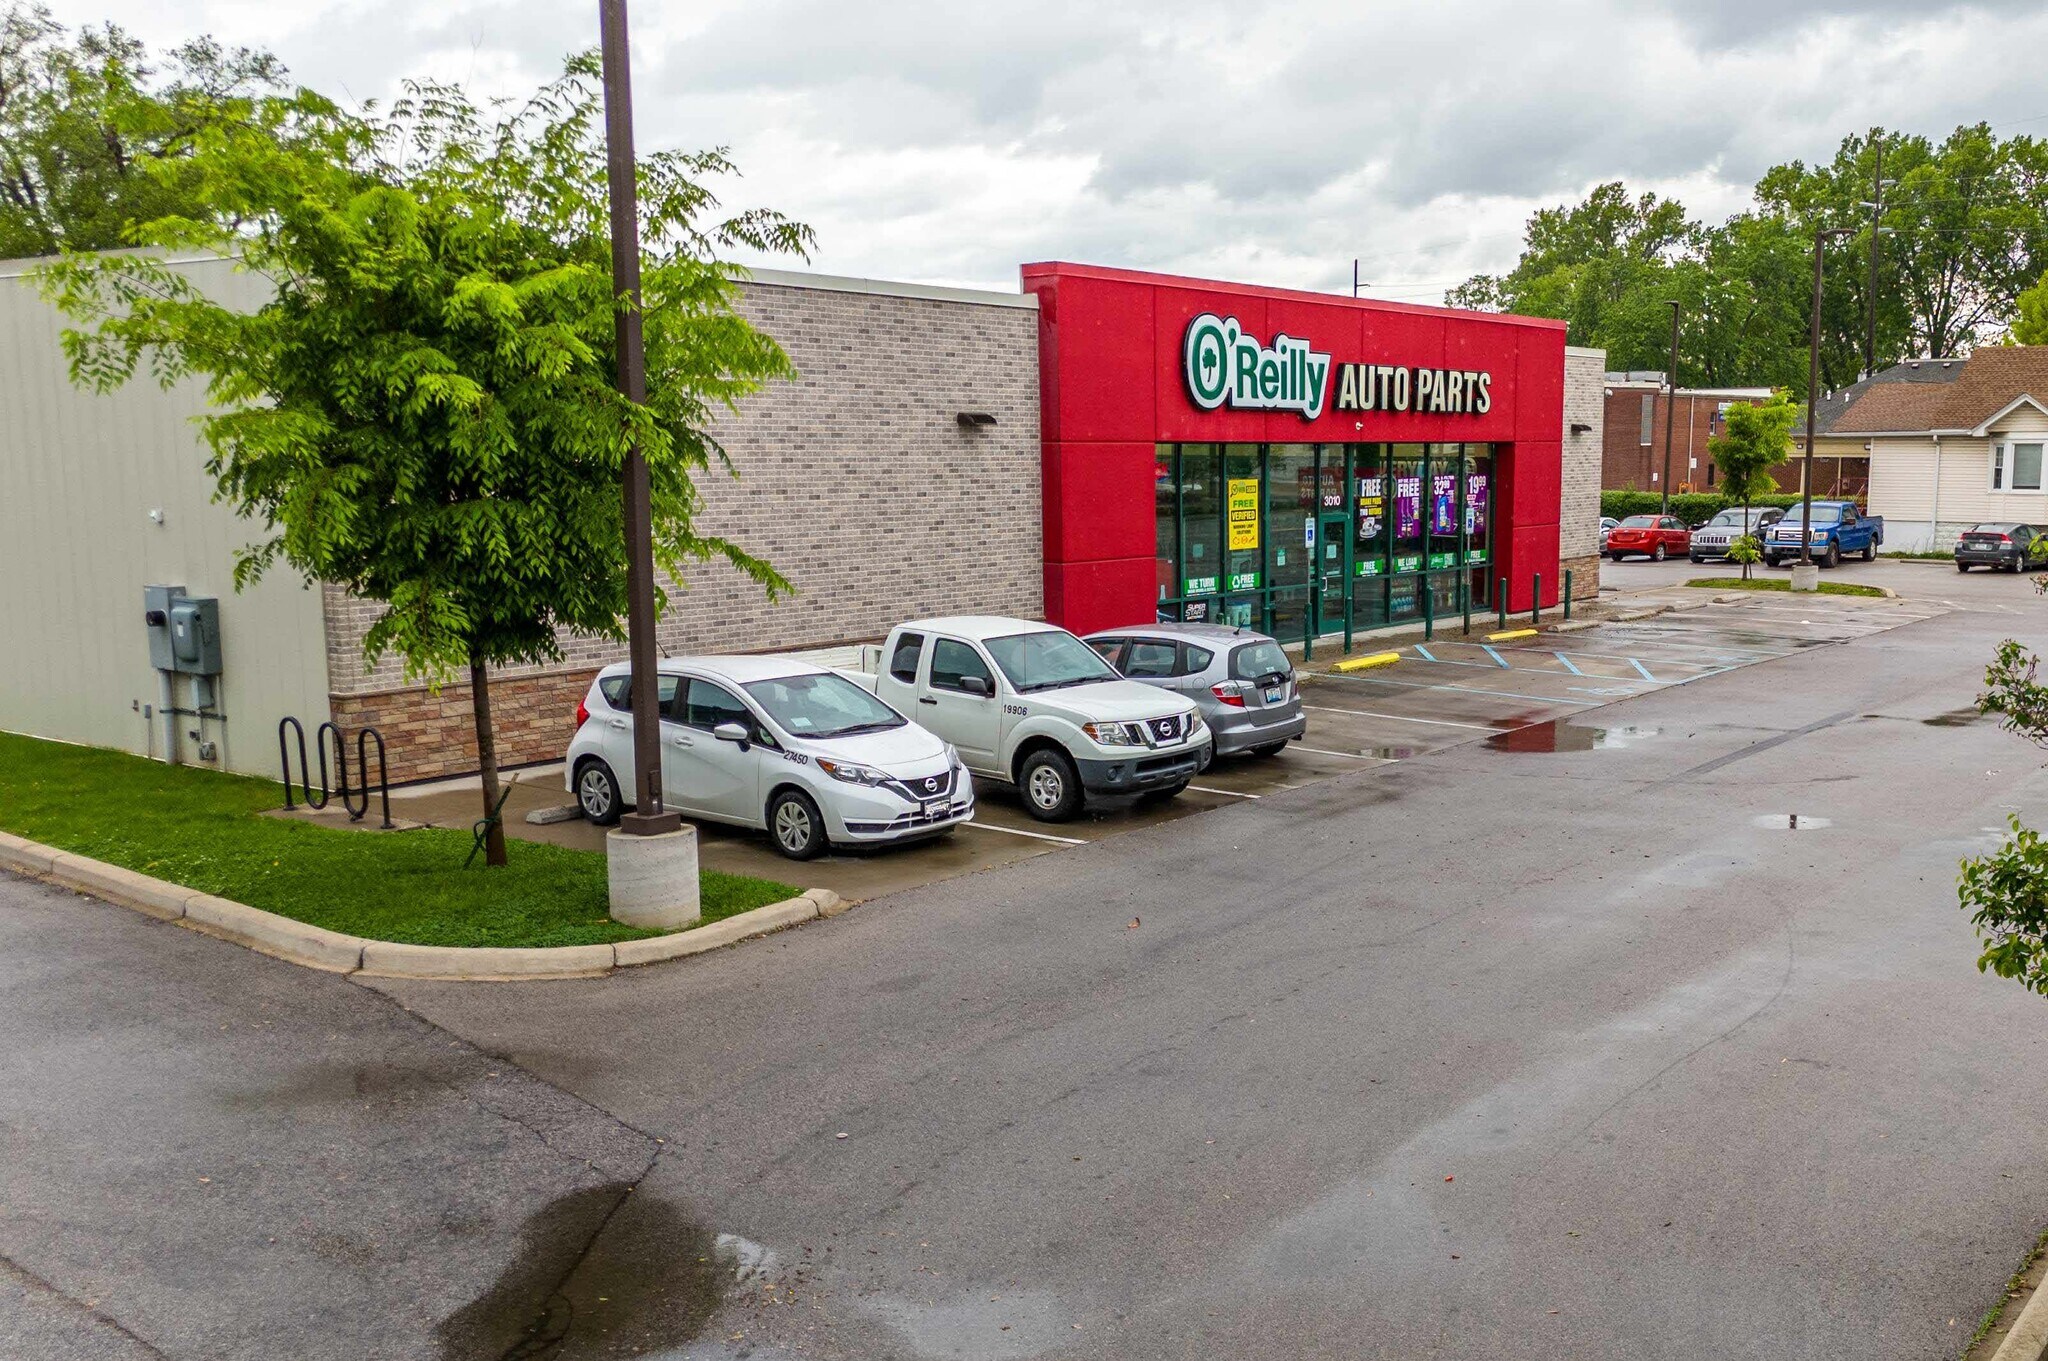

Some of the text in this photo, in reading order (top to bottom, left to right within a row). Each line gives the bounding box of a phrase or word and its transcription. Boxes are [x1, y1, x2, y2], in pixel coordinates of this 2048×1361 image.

[1191, 324, 1492, 414] O'Reilly AUTO PARTS
[1361, 478, 1381, 497] FREE
[1398, 483, 1419, 497] FREE
[1324, 496, 1341, 506] 3010
[1231, 510, 1255, 520] VERIFIED
[1470, 550, 1480, 558] FREE
[1363, 561, 1375, 570] FREE
[1240, 573, 1254, 583] FREE
[1188, 579, 1199, 588] WE
[1003, 704, 1028, 716] 19906
[783, 750, 808, 765] 27450
